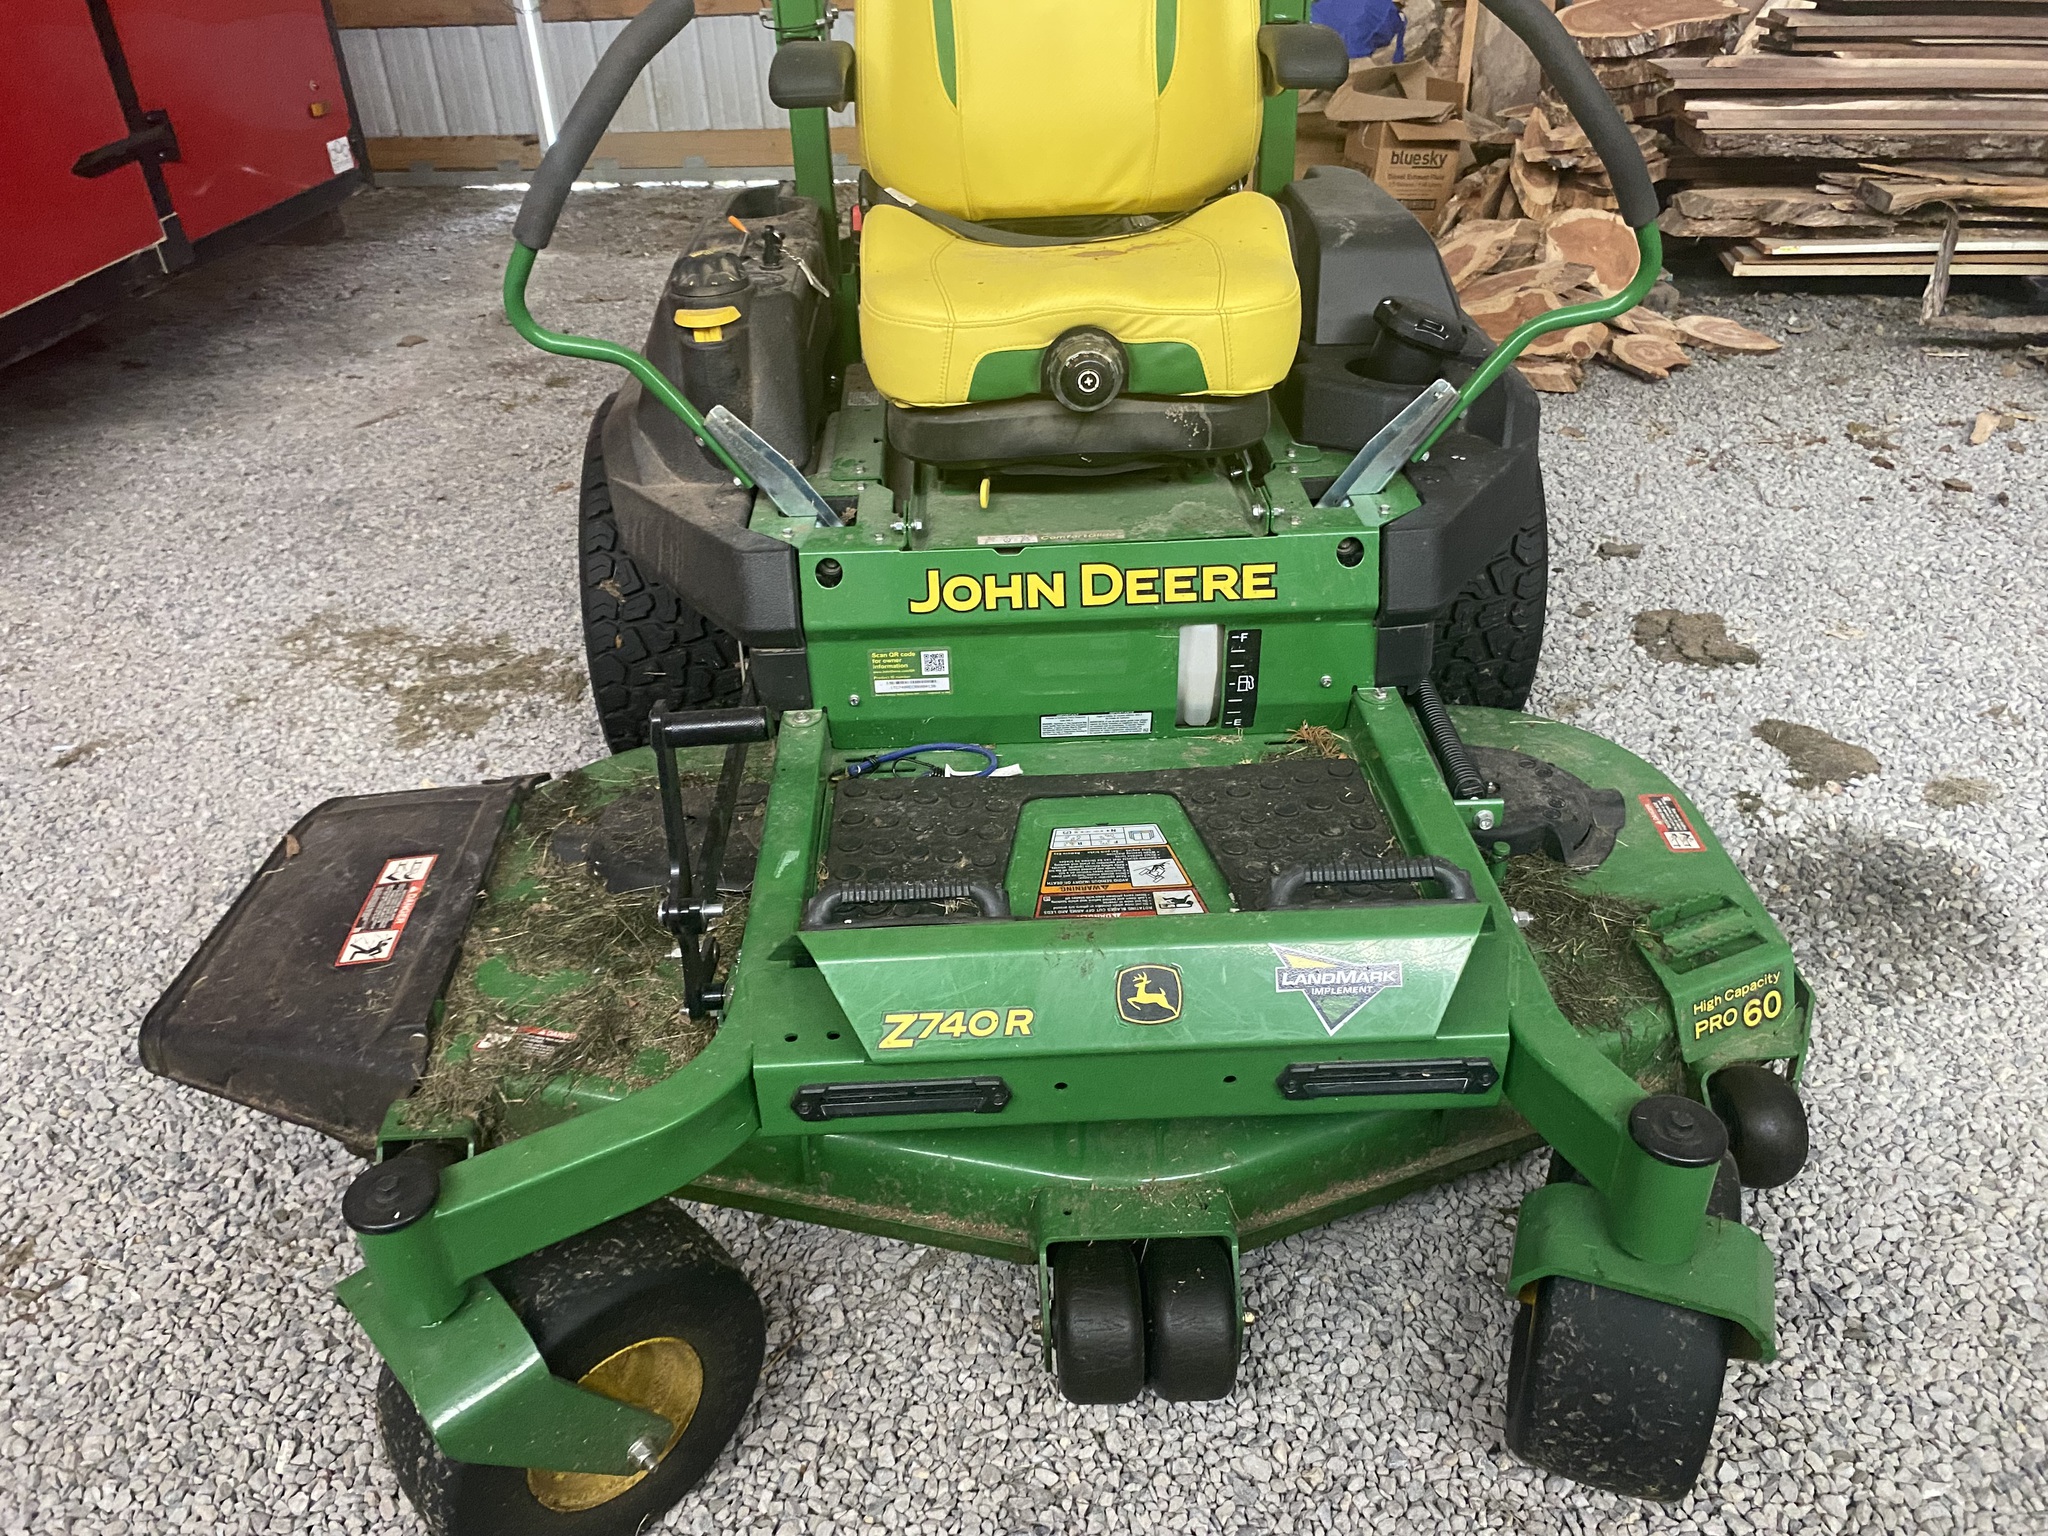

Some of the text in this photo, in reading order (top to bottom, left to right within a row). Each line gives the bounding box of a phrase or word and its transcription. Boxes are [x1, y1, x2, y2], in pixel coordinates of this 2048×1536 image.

[1390, 151, 1448, 168] bluesky
[909, 562, 1278, 614] JOHN DEERE
[1240, 632, 1248, 642] F
[1233, 718, 1242, 726] E
[1311, 986, 1374, 995] IMPLEMENT
[1693, 971, 1781, 1016] High Capacity
[1695, 989, 1782, 1040] PRO 60
